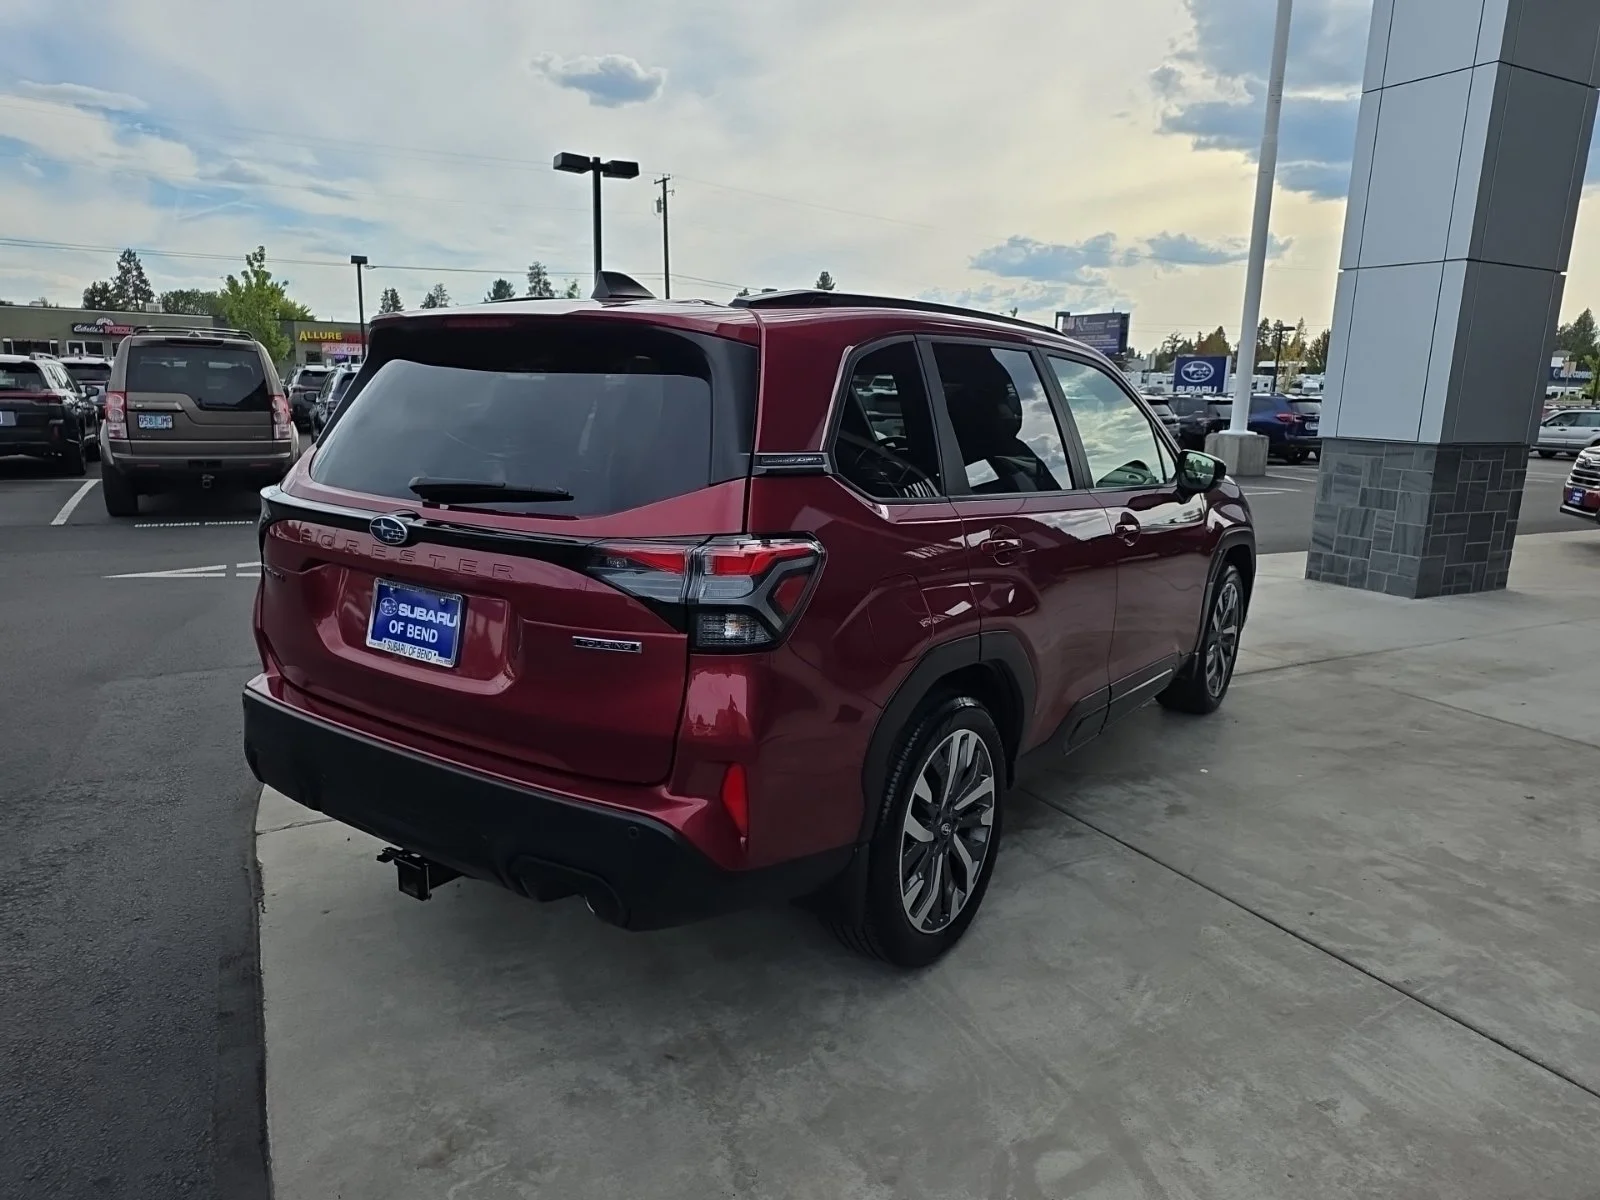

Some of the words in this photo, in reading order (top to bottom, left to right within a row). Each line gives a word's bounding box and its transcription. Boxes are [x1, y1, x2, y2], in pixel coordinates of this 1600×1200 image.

[299, 330, 343, 341] ALLURE
[1176, 385, 1218, 395] SUBARU
[299, 525, 514, 580] FORESTER
[398, 603, 457, 627] SUBARU
[388, 619, 405, 635] OF
[406, 623, 439, 643] BEND
[386, 640, 407, 655] SUBARU
[408, 645, 416, 655] OF
[416, 648, 433, 661] BEND
[579, 639, 632, 650] TOURING
